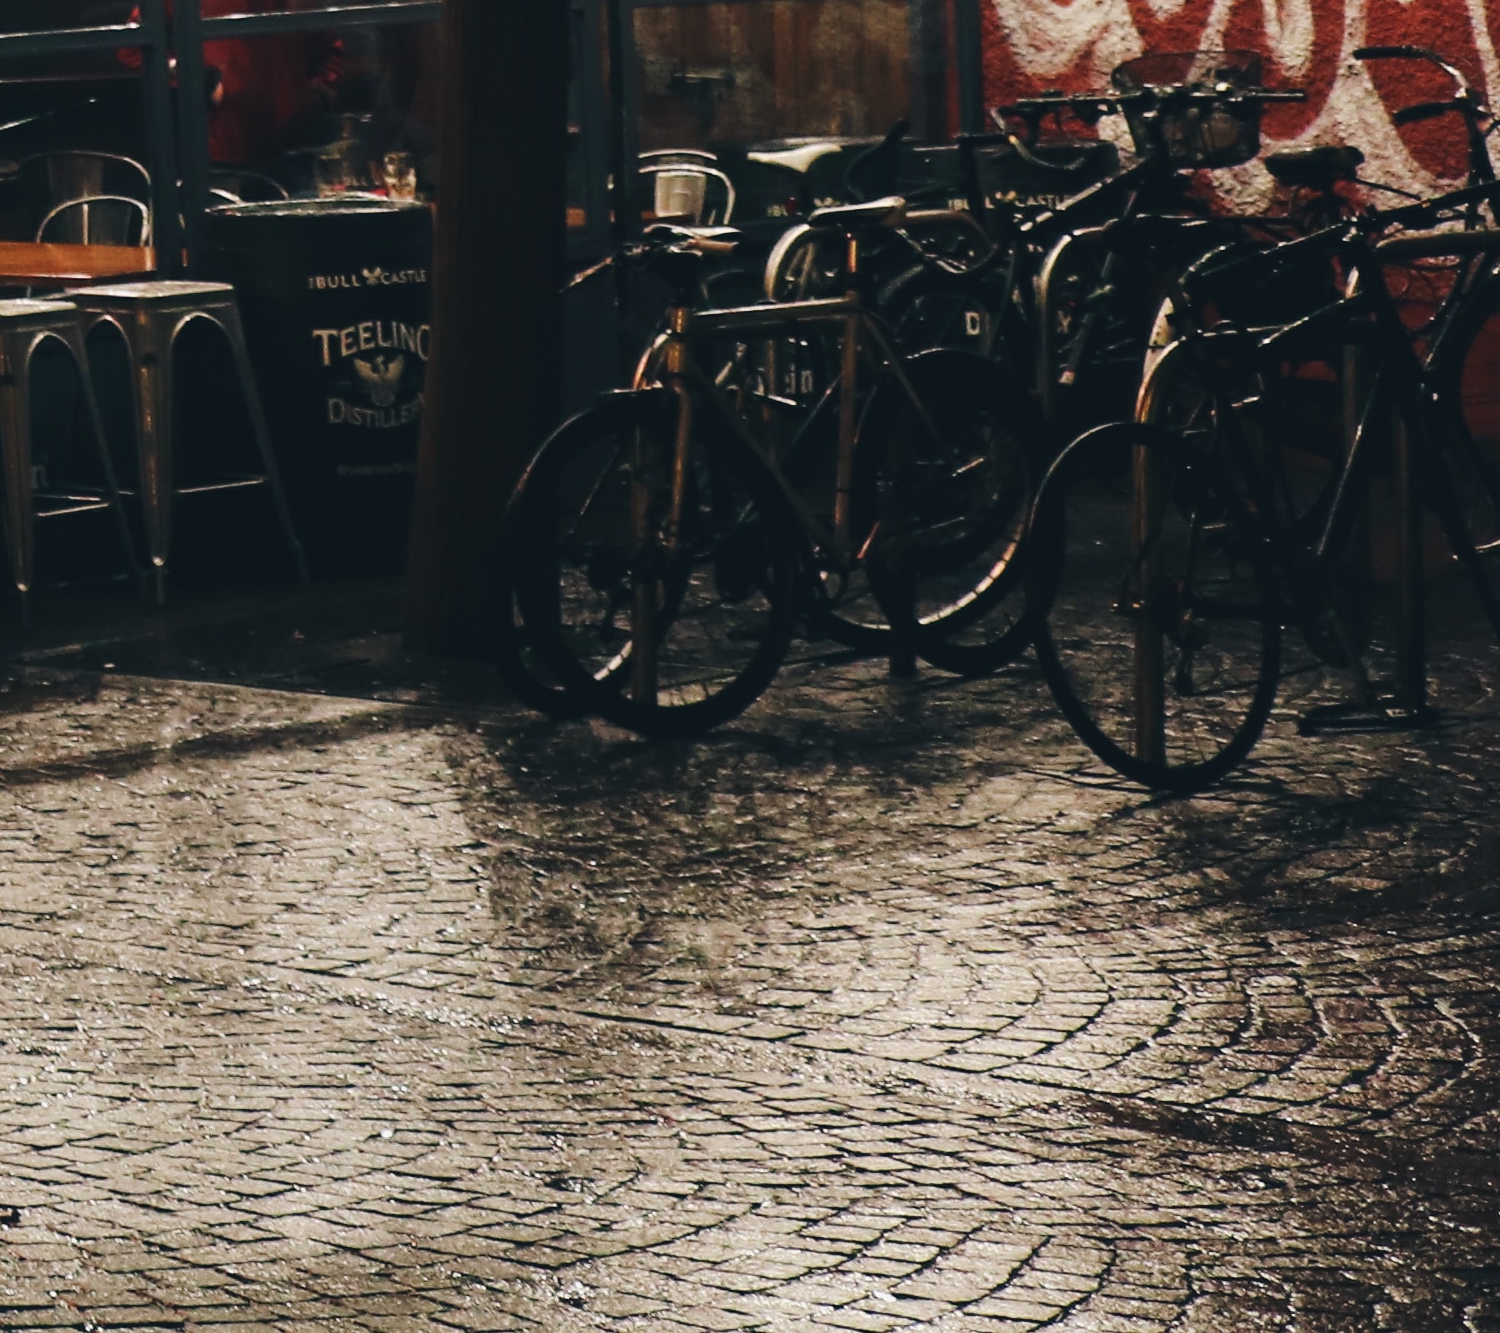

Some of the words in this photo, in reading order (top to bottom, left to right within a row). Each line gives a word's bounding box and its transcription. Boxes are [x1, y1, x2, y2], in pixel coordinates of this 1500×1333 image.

[316, 275, 361, 290] BULL
[381, 269, 427, 285] CASTLE
[327, 393, 426, 429] DISTILLER
